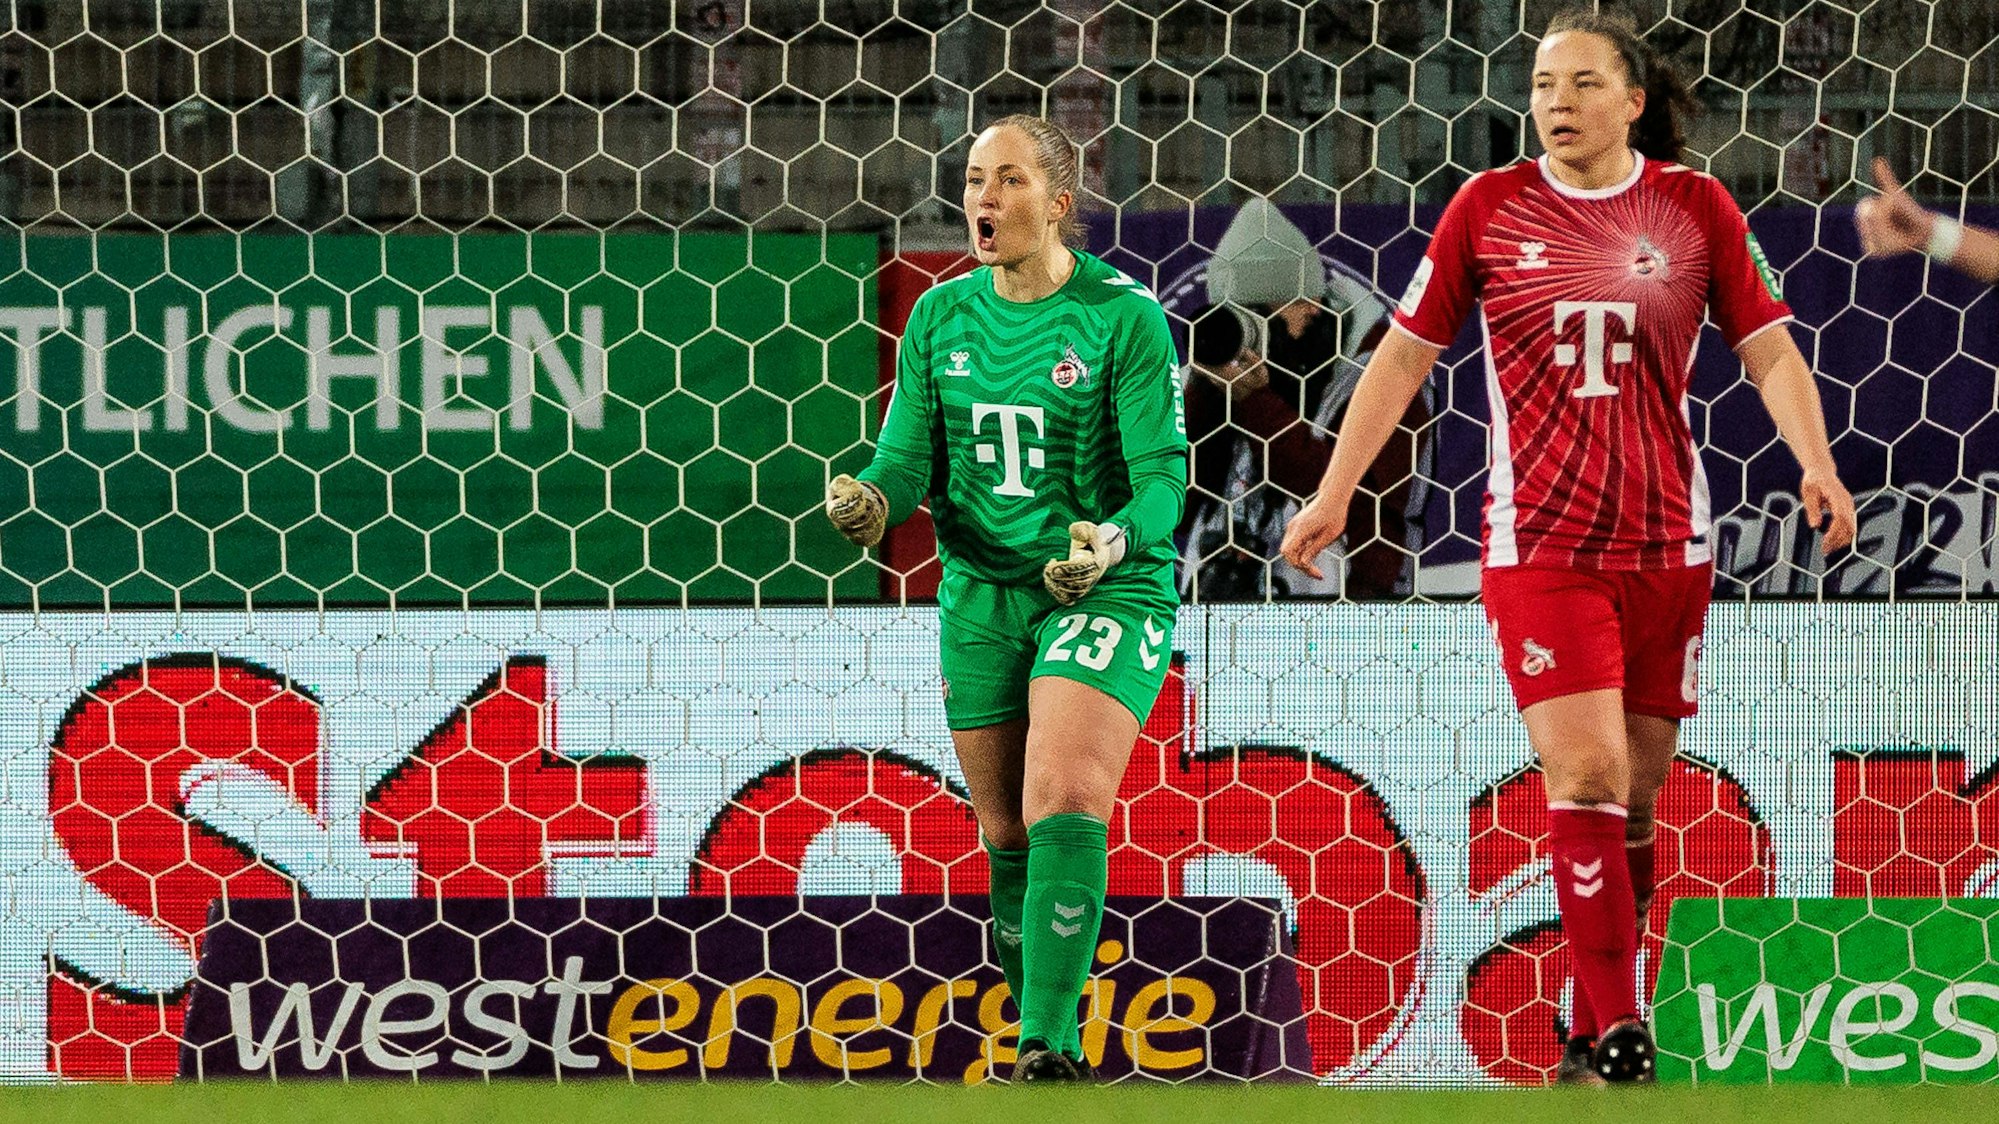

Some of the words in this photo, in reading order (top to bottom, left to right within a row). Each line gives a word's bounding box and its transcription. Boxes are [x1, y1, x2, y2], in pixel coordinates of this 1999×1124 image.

[0, 304, 606, 433] TLICHEN
[1553, 301, 1636, 398] T
[971, 402, 1045, 498] T
[1043, 612, 1123, 672] 23
[229, 938, 1217, 1084] westenergie
[1697, 981, 1999, 1072] wes
